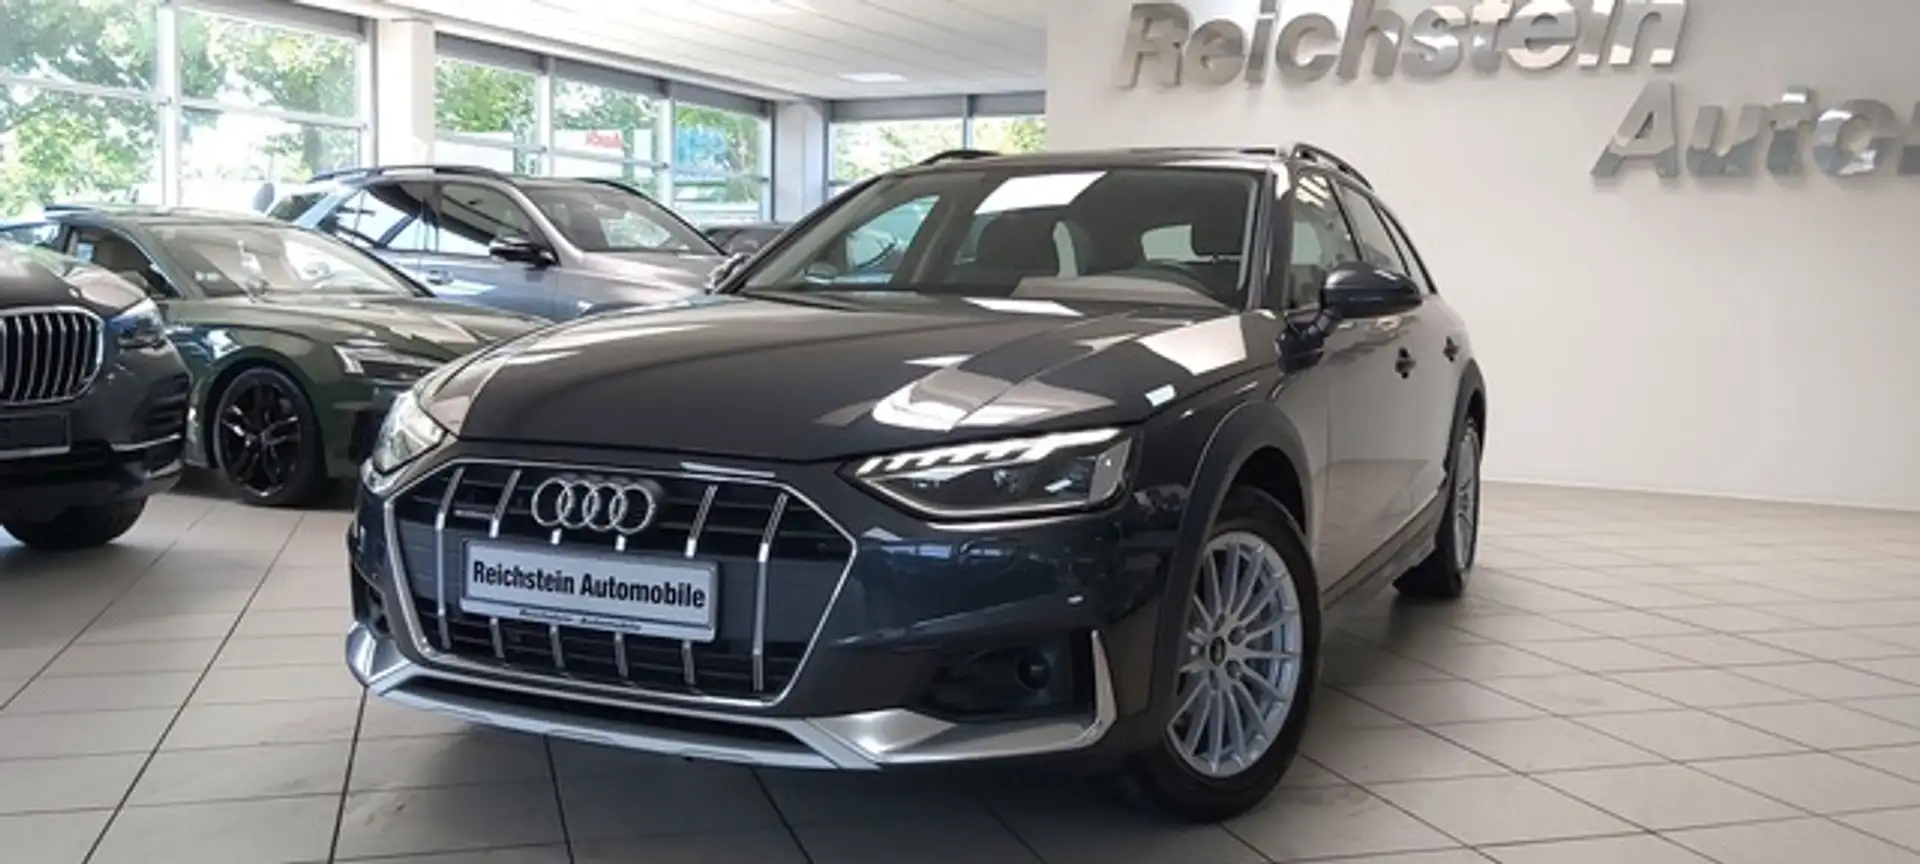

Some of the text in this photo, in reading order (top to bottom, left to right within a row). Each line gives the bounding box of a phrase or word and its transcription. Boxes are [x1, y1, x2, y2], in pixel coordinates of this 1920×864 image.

[1120, 0, 1687, 88] Reichstein
[1591, 81, 1920, 177] Auto
[473, 561, 706, 608] Reichstein Automobile
